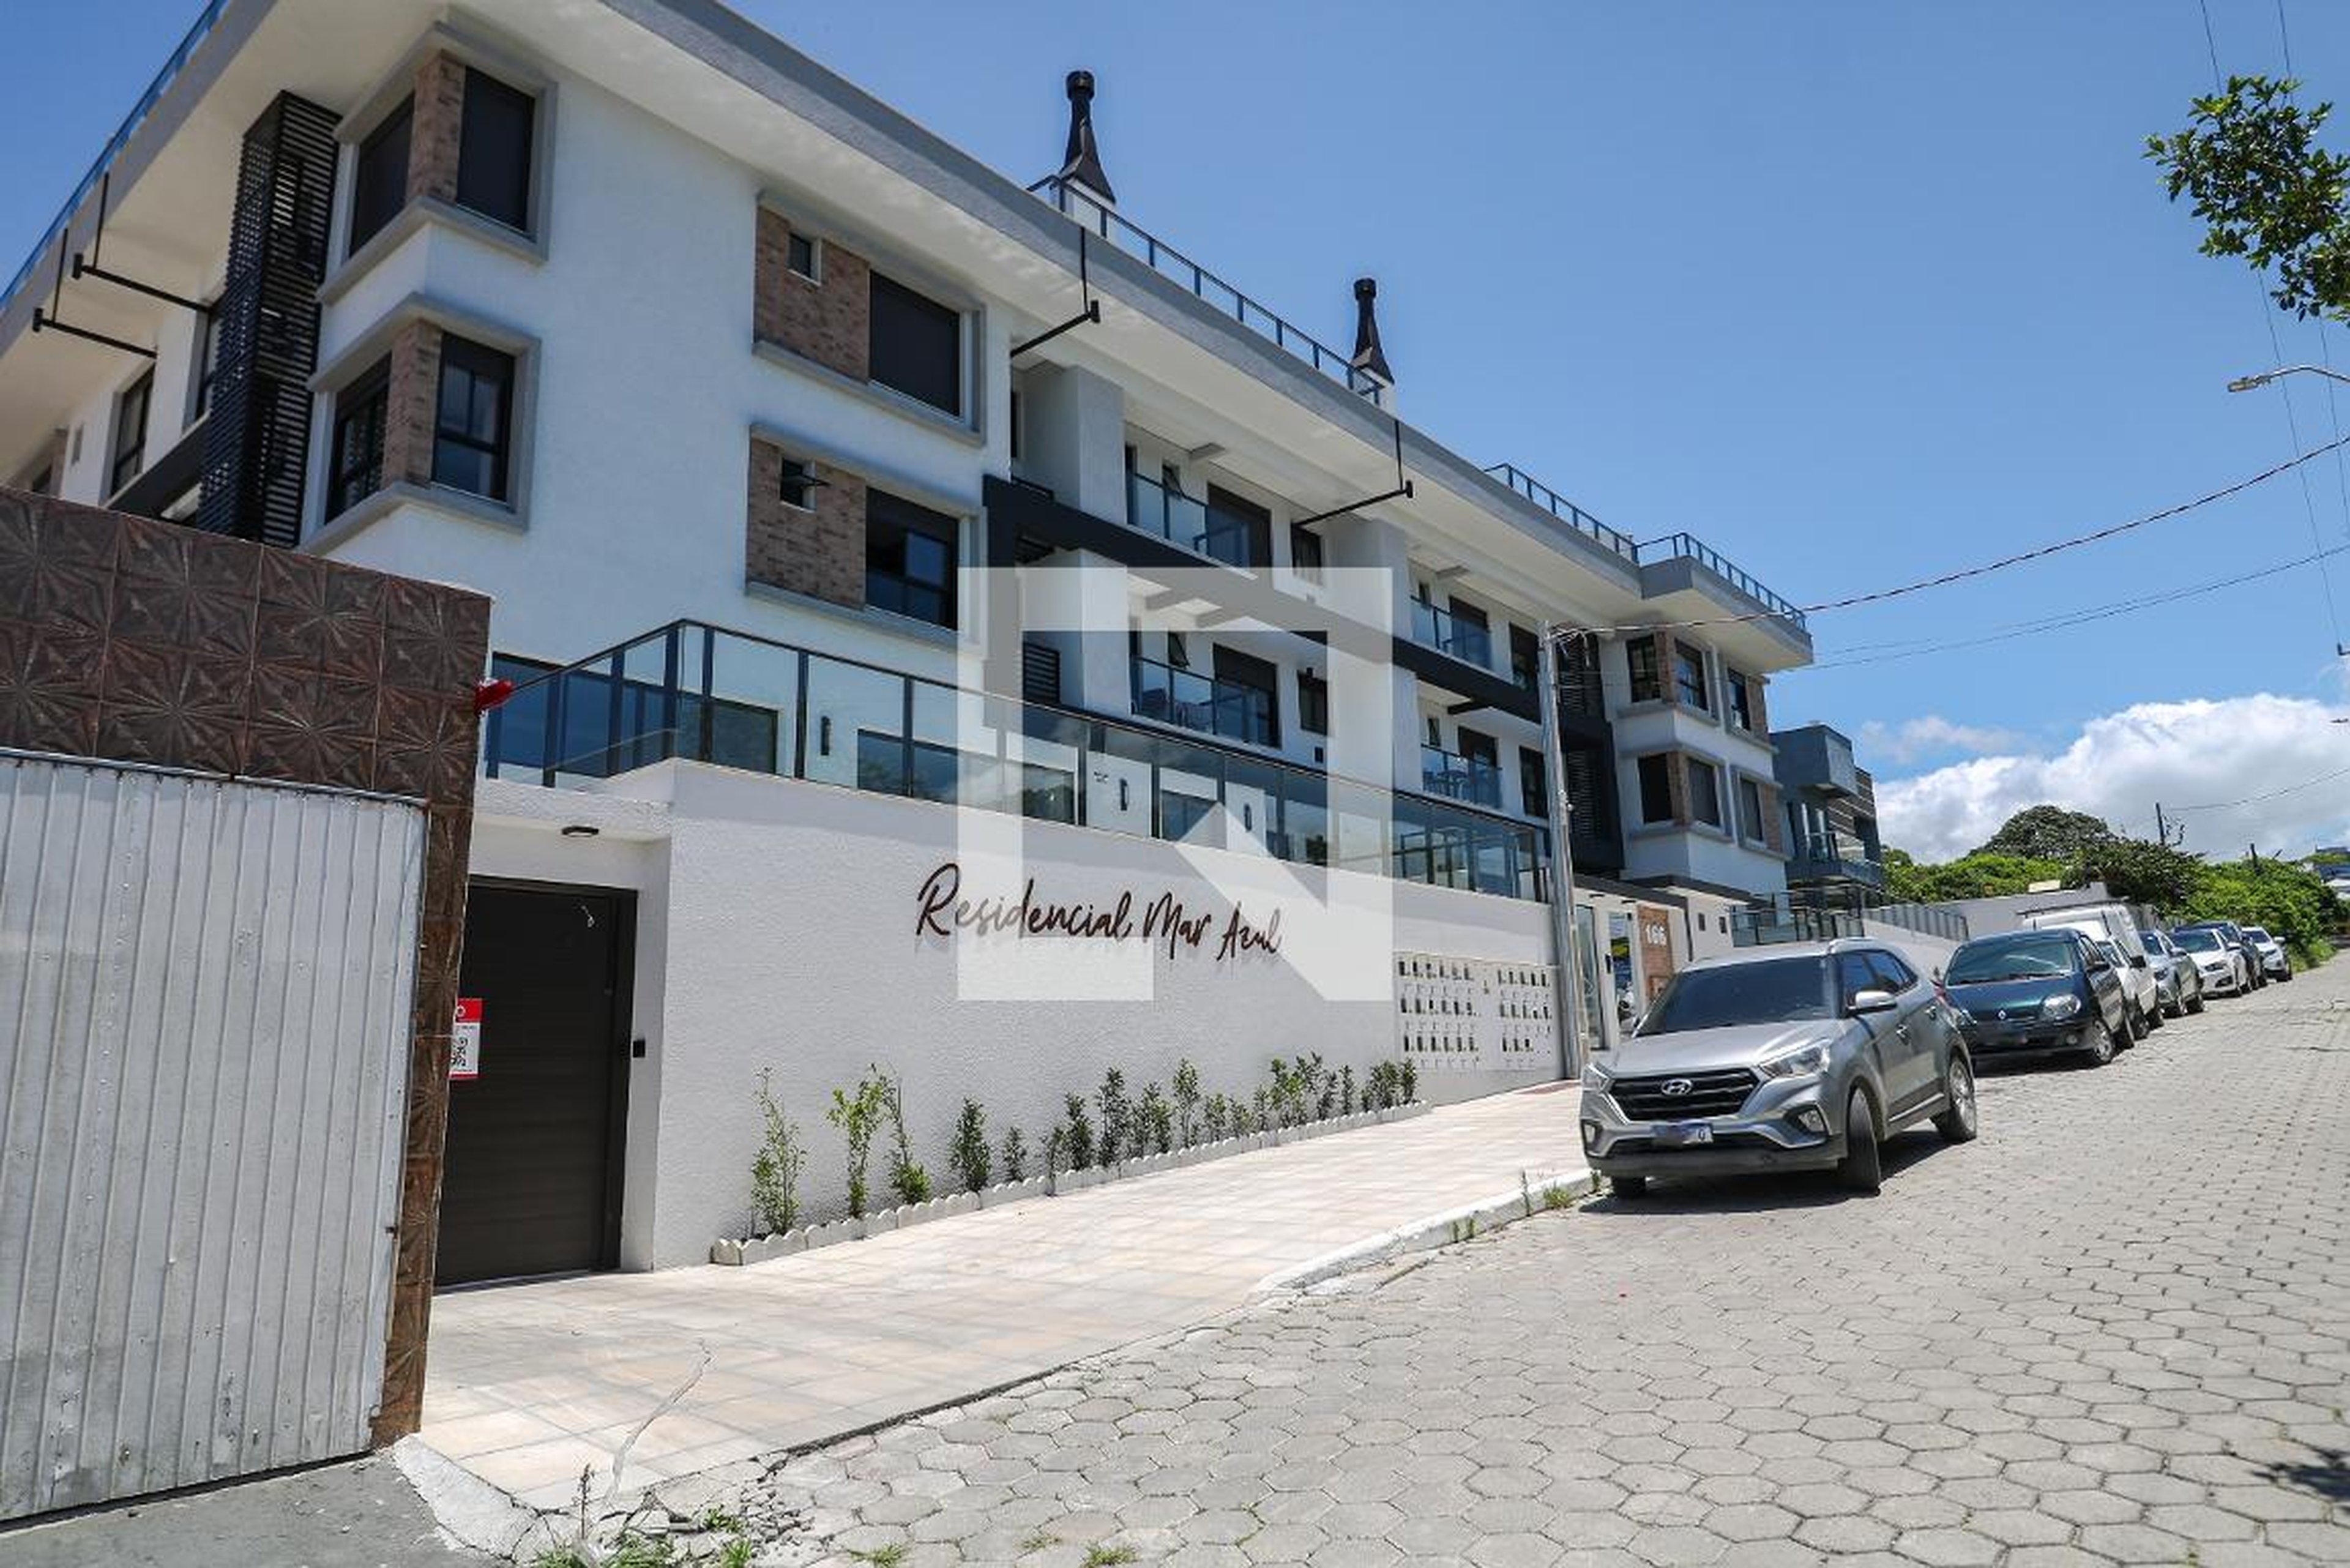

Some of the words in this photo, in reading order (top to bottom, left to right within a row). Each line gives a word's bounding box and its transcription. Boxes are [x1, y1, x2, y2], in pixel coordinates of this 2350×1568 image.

[916, 863, 1132, 941] Residencial
[1143, 892, 1211, 960] Mar
[1217, 901, 1281, 961] Azul
